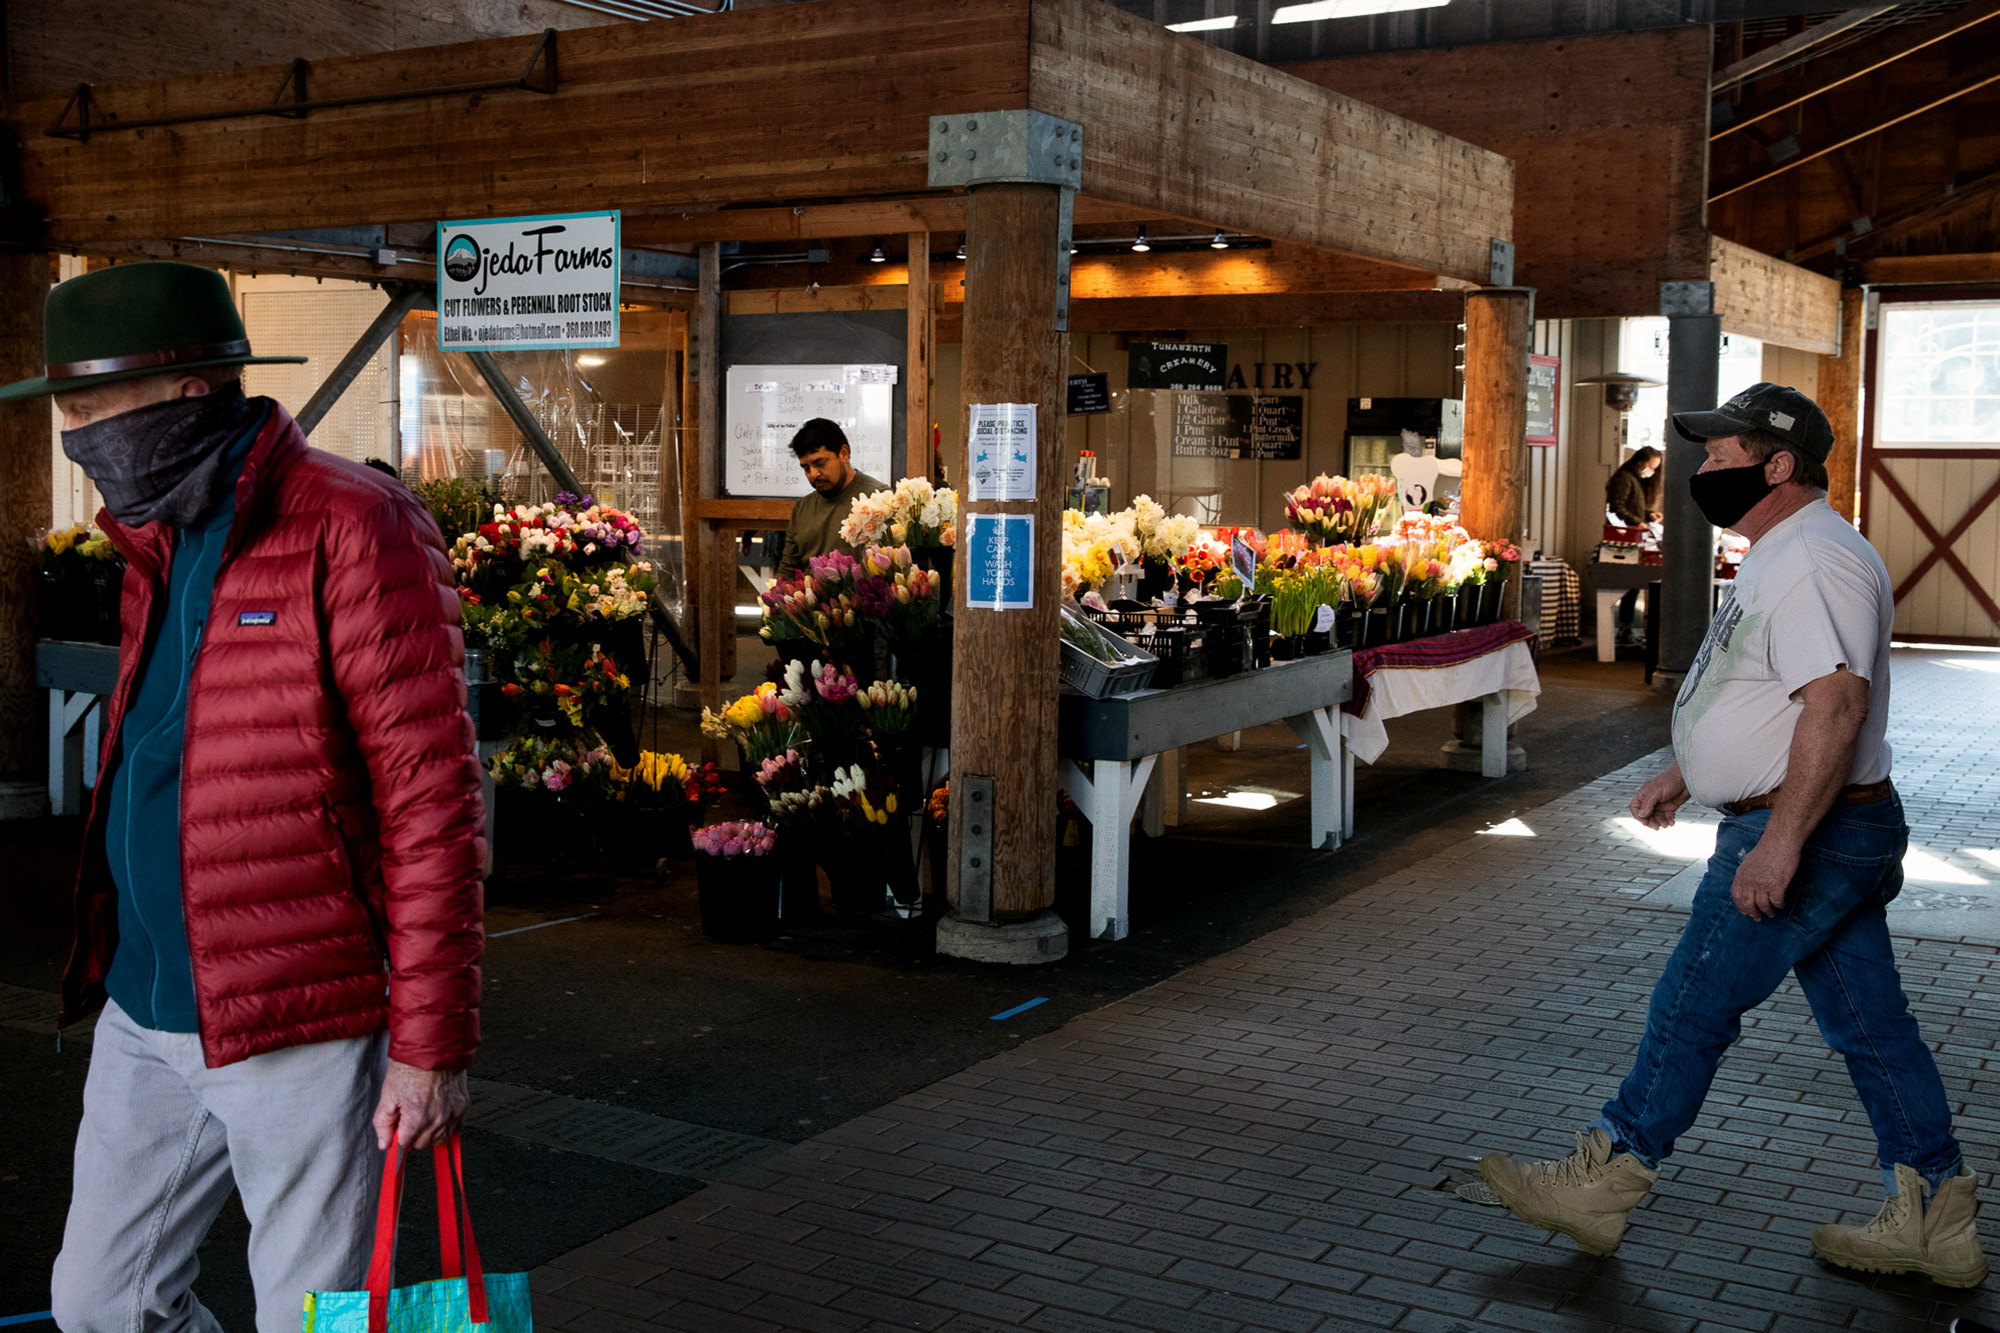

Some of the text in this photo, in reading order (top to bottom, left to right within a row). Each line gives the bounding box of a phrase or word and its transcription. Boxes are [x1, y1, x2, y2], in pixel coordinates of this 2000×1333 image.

[444, 225, 612, 295] Ojeda Farms
[444, 292, 612, 317] CUT FLOWERS & PERENNIAL ROOT STOCK
[444, 326, 460, 342] Ethel
[478, 323, 561, 342] ojedafarms@hotmail.com
[566, 320, 611, 338] 360.880.8493
[1152, 342, 1212, 353] TUNAWERTH
[1160, 356, 1217, 374] CREAMERY
[1228, 362, 1318, 388] AIRY
[1178, 394, 1199, 404] Milk
[1184, 404, 1216, 414] Gallon
[1258, 406, 1285, 416] Quart
[1177, 415, 1226, 425] 1/2 Gallon
[1259, 417, 1277, 425] Pint
[1184, 425, 1205, 435] Pint
[1218, 436, 1239, 446] Pint
